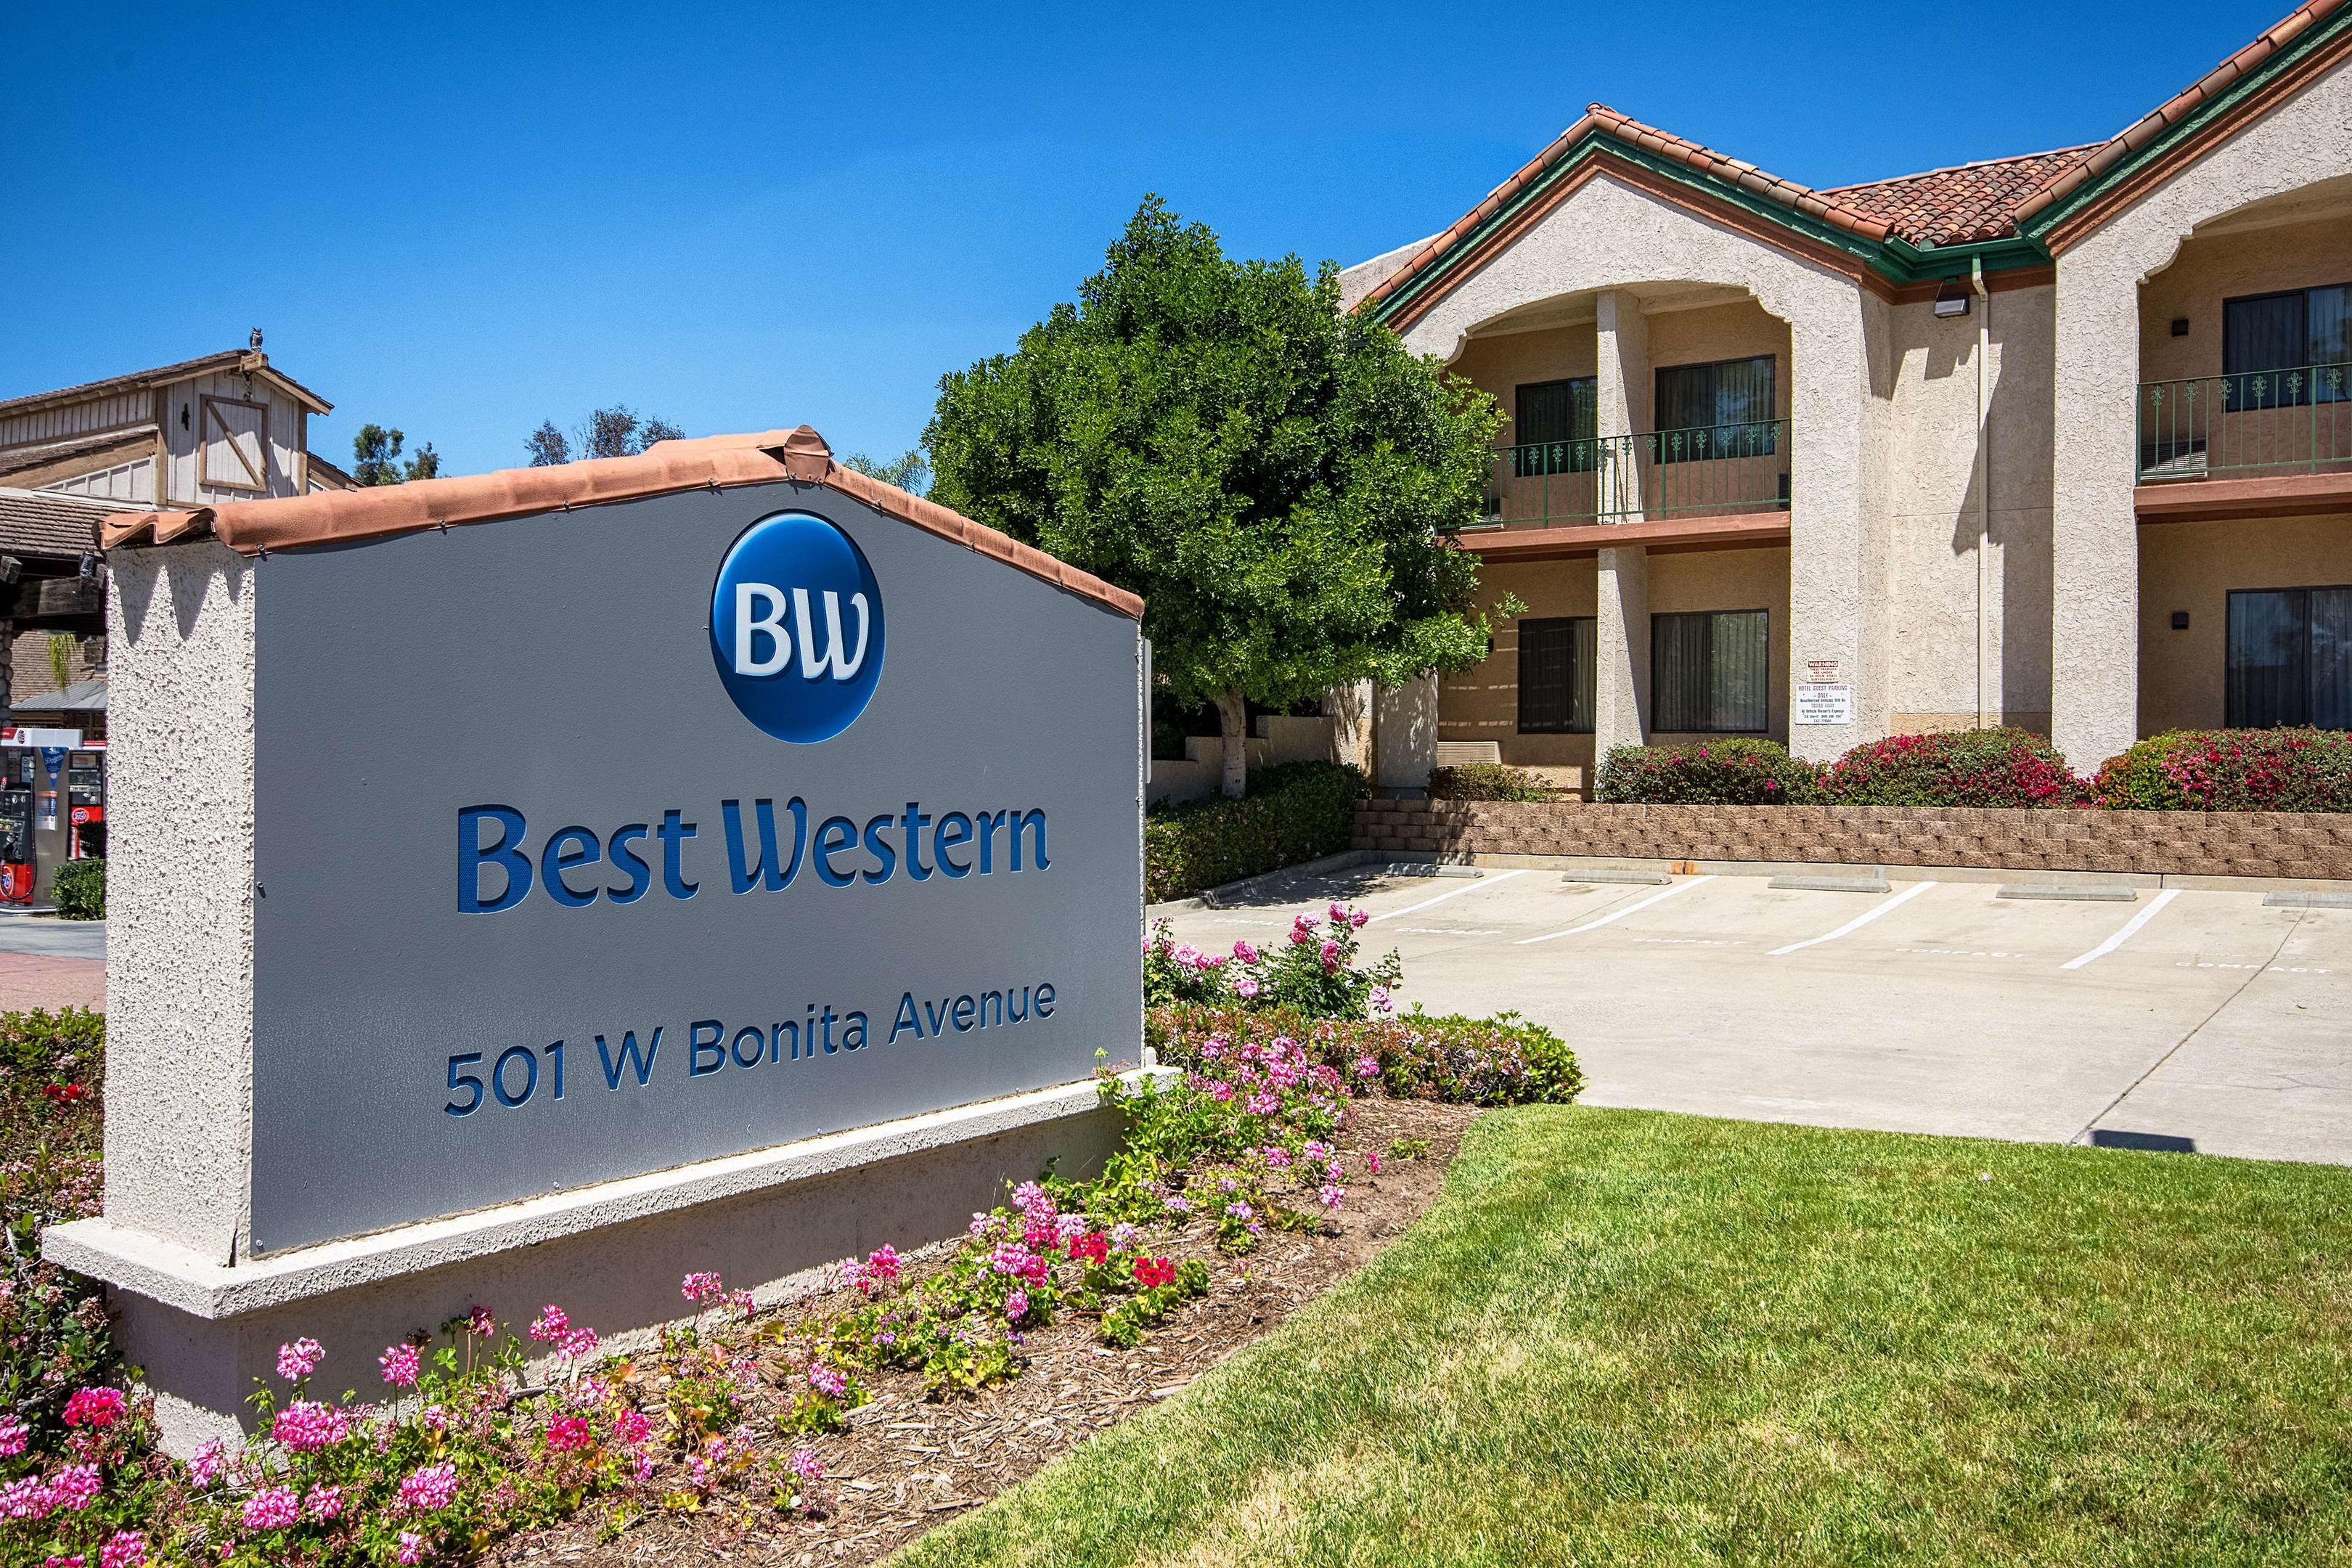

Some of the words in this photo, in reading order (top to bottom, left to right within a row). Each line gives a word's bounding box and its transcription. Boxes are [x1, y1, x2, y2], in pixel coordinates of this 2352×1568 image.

[735, 582, 869, 680] BW
[458, 804, 700, 915] Best
[722, 796, 1050, 894] Western
[1895, 947, 2028, 958] COMPACT
[2175, 962, 2332, 973] COMPACT
[444, 1040, 565, 1118] 501
[595, 1026, 663, 1091] W
[690, 1003, 870, 1078] Bonita
[889, 982, 1057, 1045] Avenue
